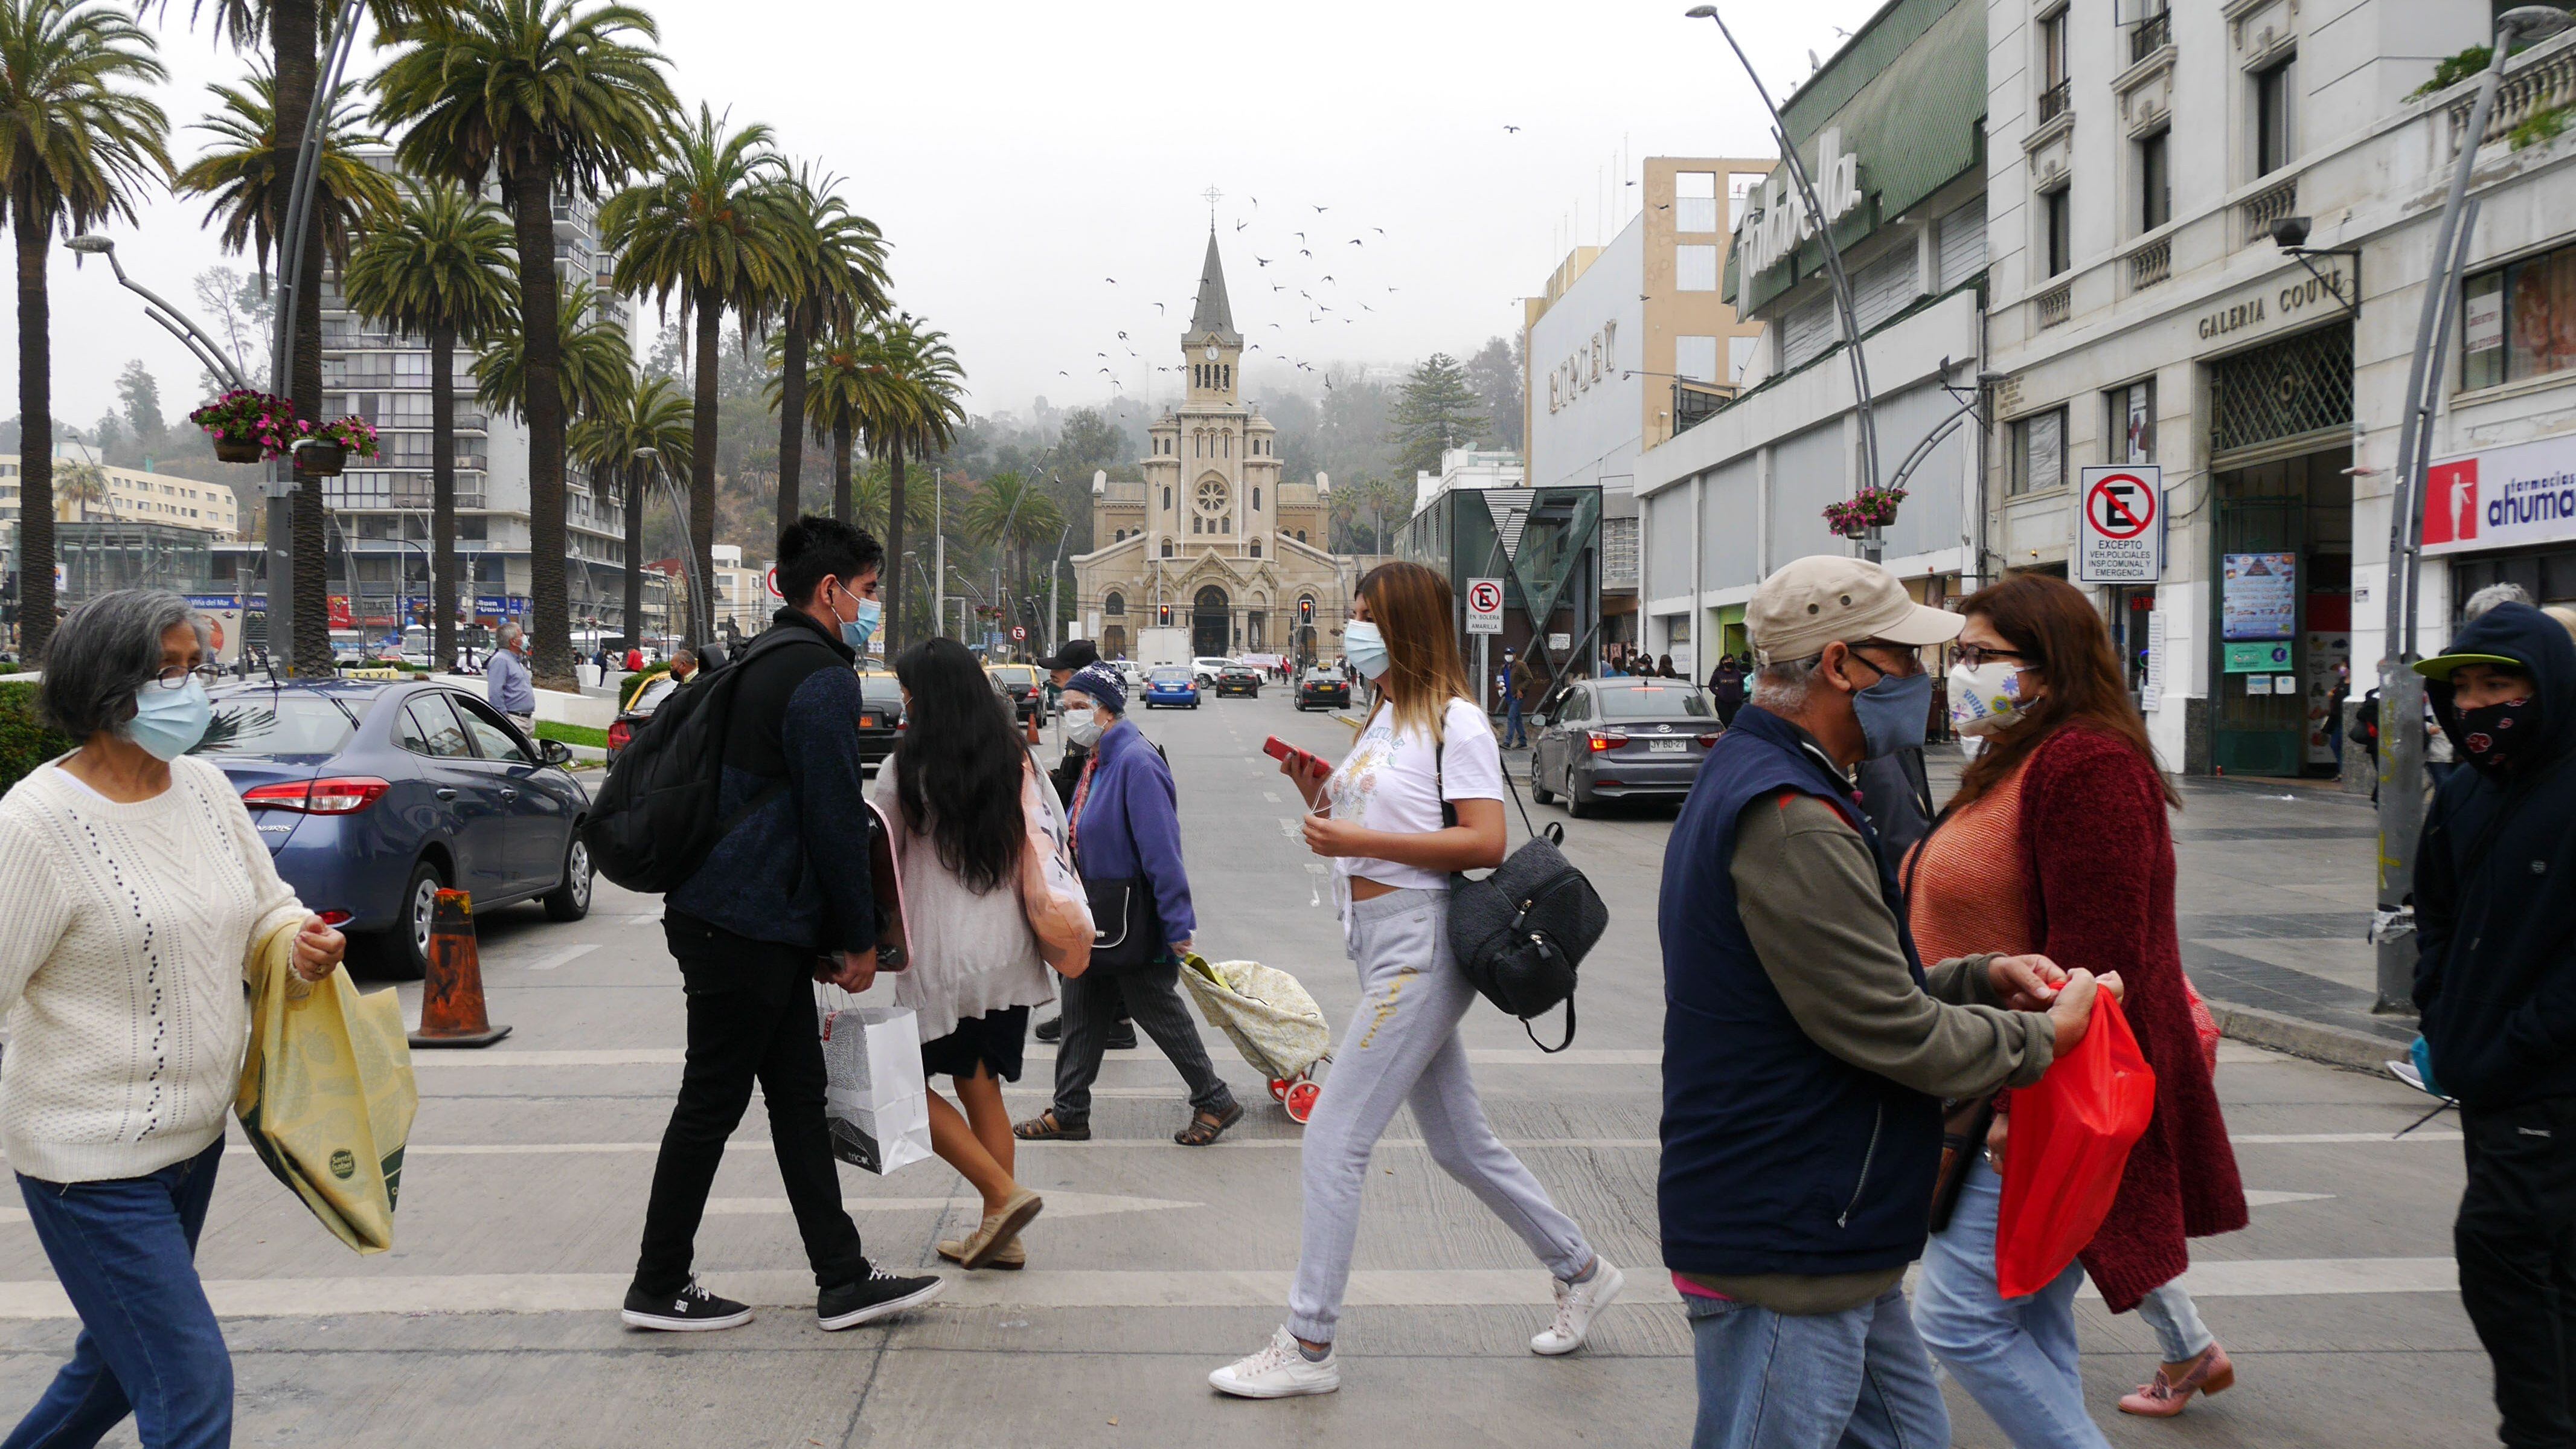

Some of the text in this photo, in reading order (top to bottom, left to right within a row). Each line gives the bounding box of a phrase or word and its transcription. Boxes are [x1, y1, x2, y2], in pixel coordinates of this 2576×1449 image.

[2199, 269, 2343, 339] GALERIA COUVE
[1549, 318, 1617, 414] RIPLEY
[2511, 471, 2575, 493] farmacias
[2099, 540, 2142, 550] EXCEPTO
[191, 597, 205, 606] Viña
[206, 597, 216, 606] del
[1651, 740, 1660, 748] JY
[333, 1154, 352, 1165] Santa
